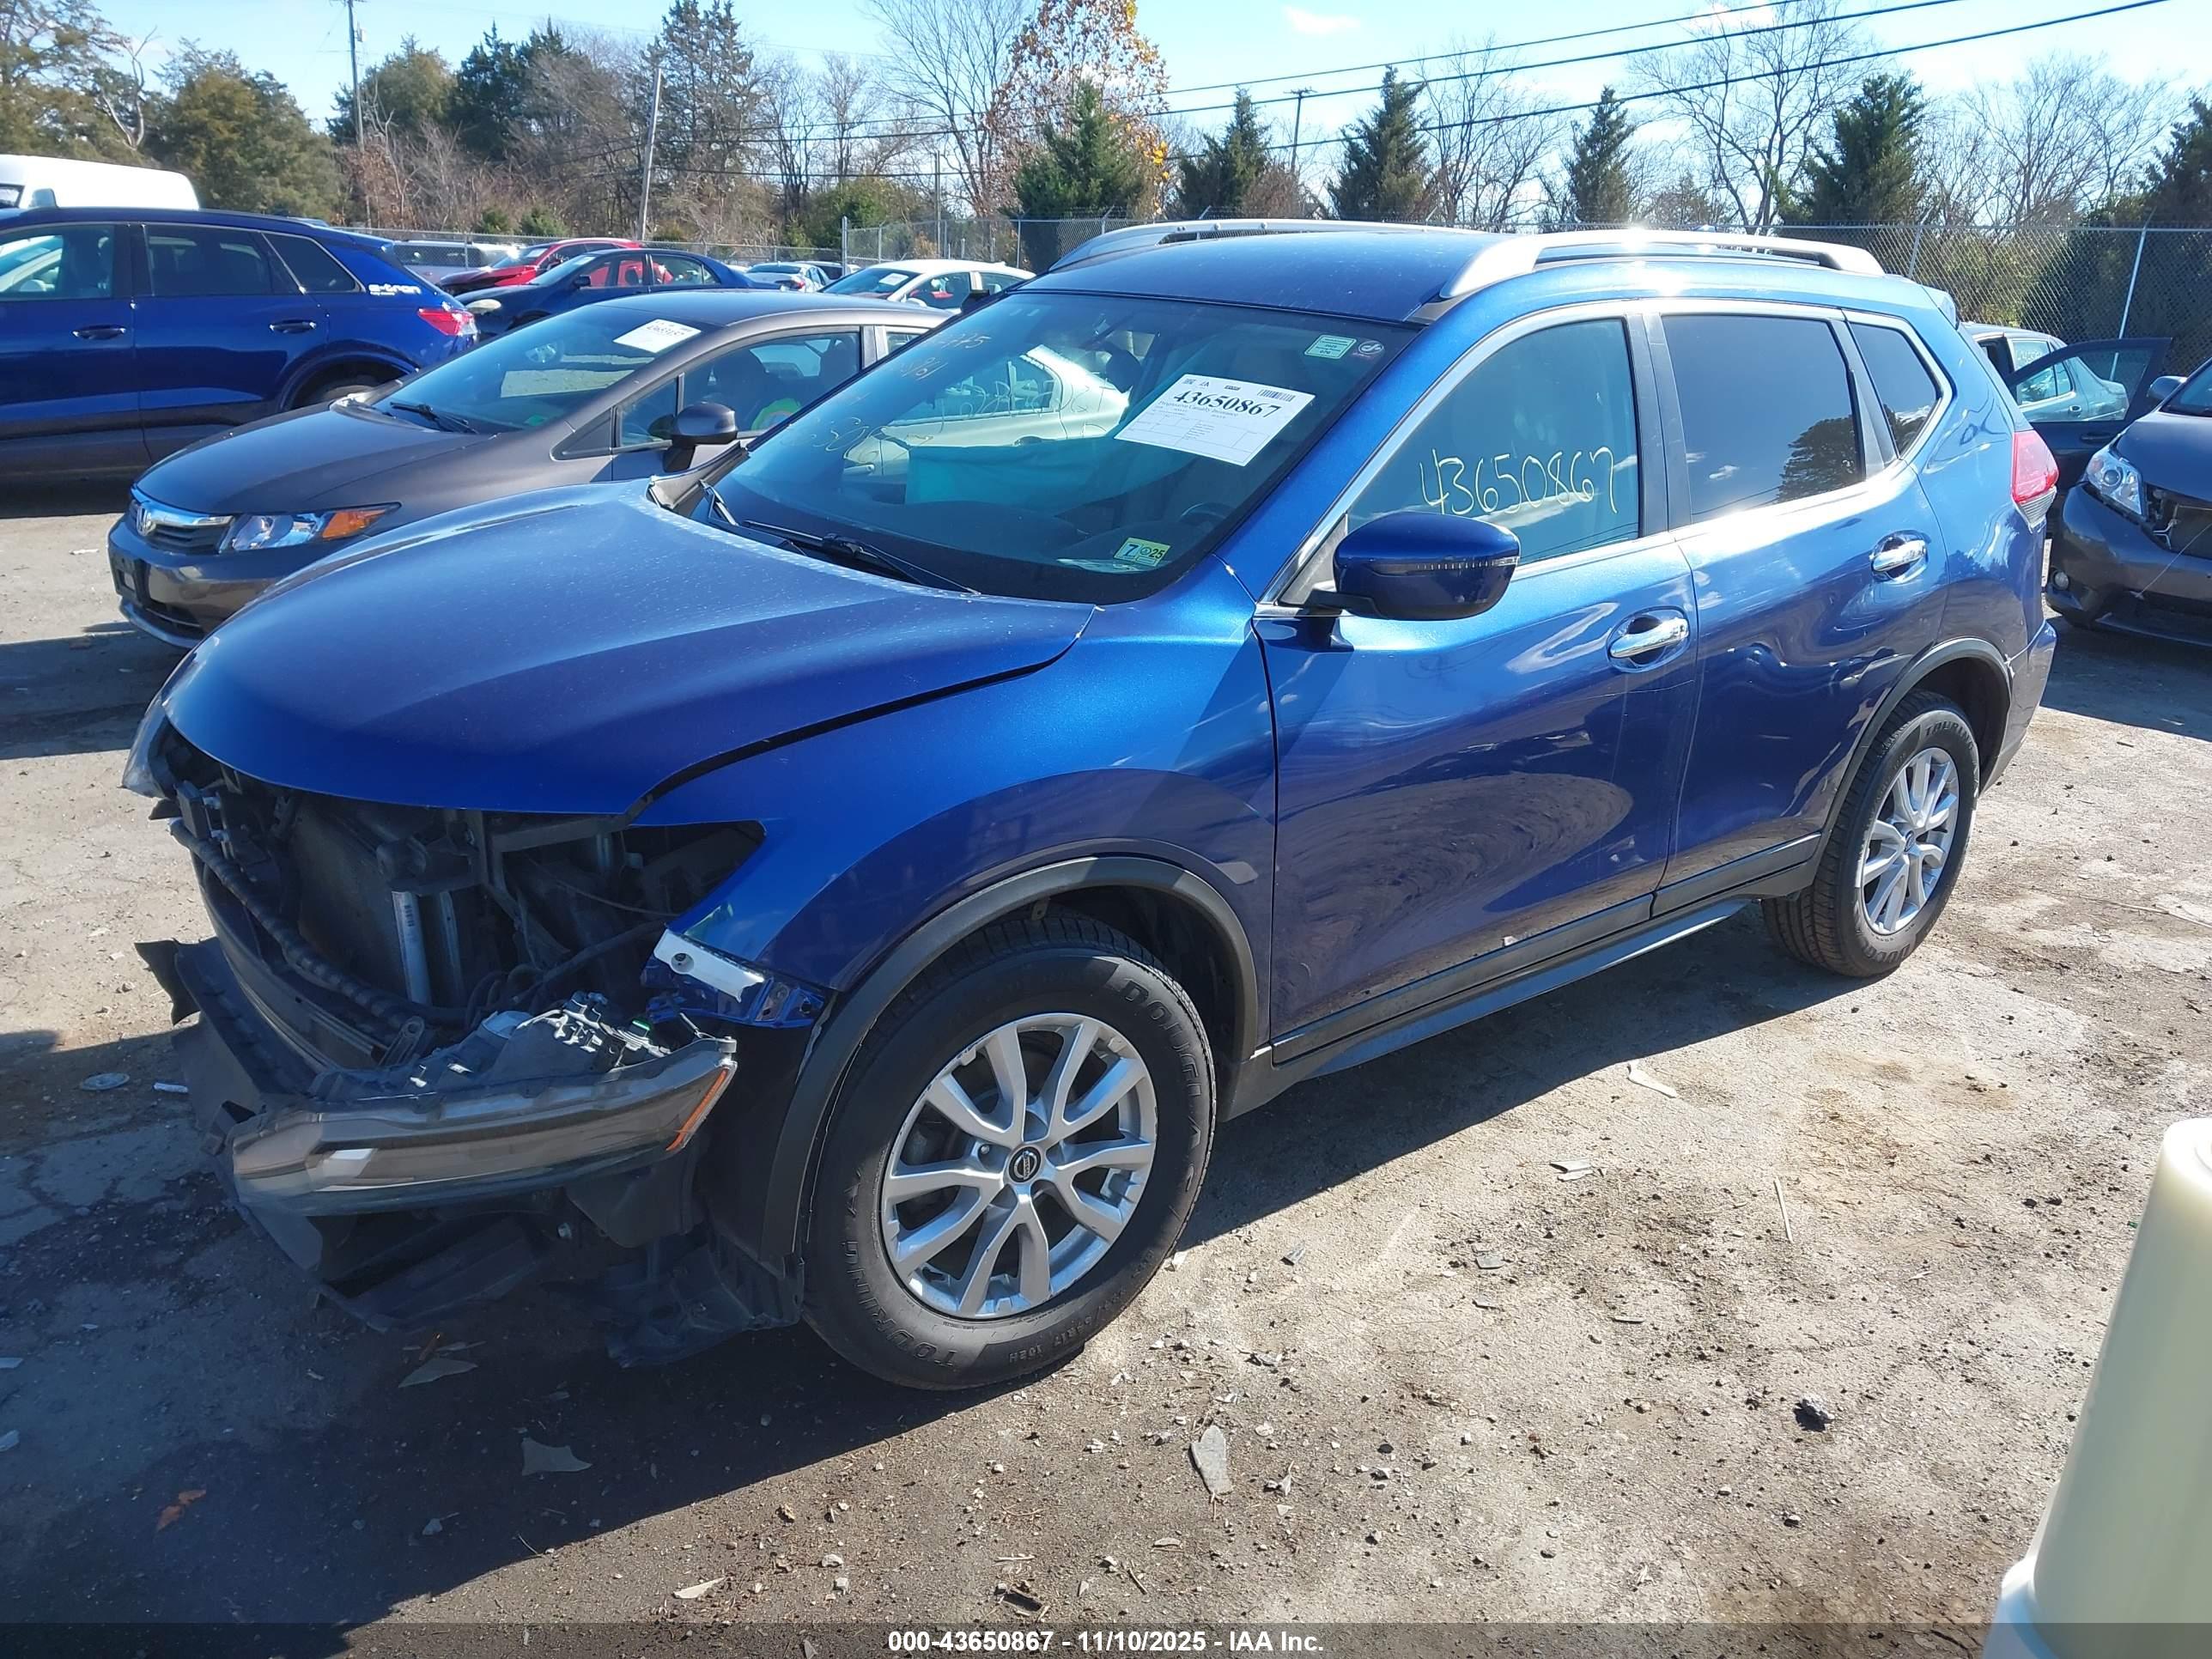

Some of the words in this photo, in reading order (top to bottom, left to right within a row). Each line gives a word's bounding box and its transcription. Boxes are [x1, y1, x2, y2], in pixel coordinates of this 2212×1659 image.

[368, 283, 422, 295] e-tron
[1173, 389, 1282, 418] 43650867
[1419, 446, 1618, 515] 43650867
[1122, 544, 1139, 557] 7
[1149, 548, 1165, 559] 25
